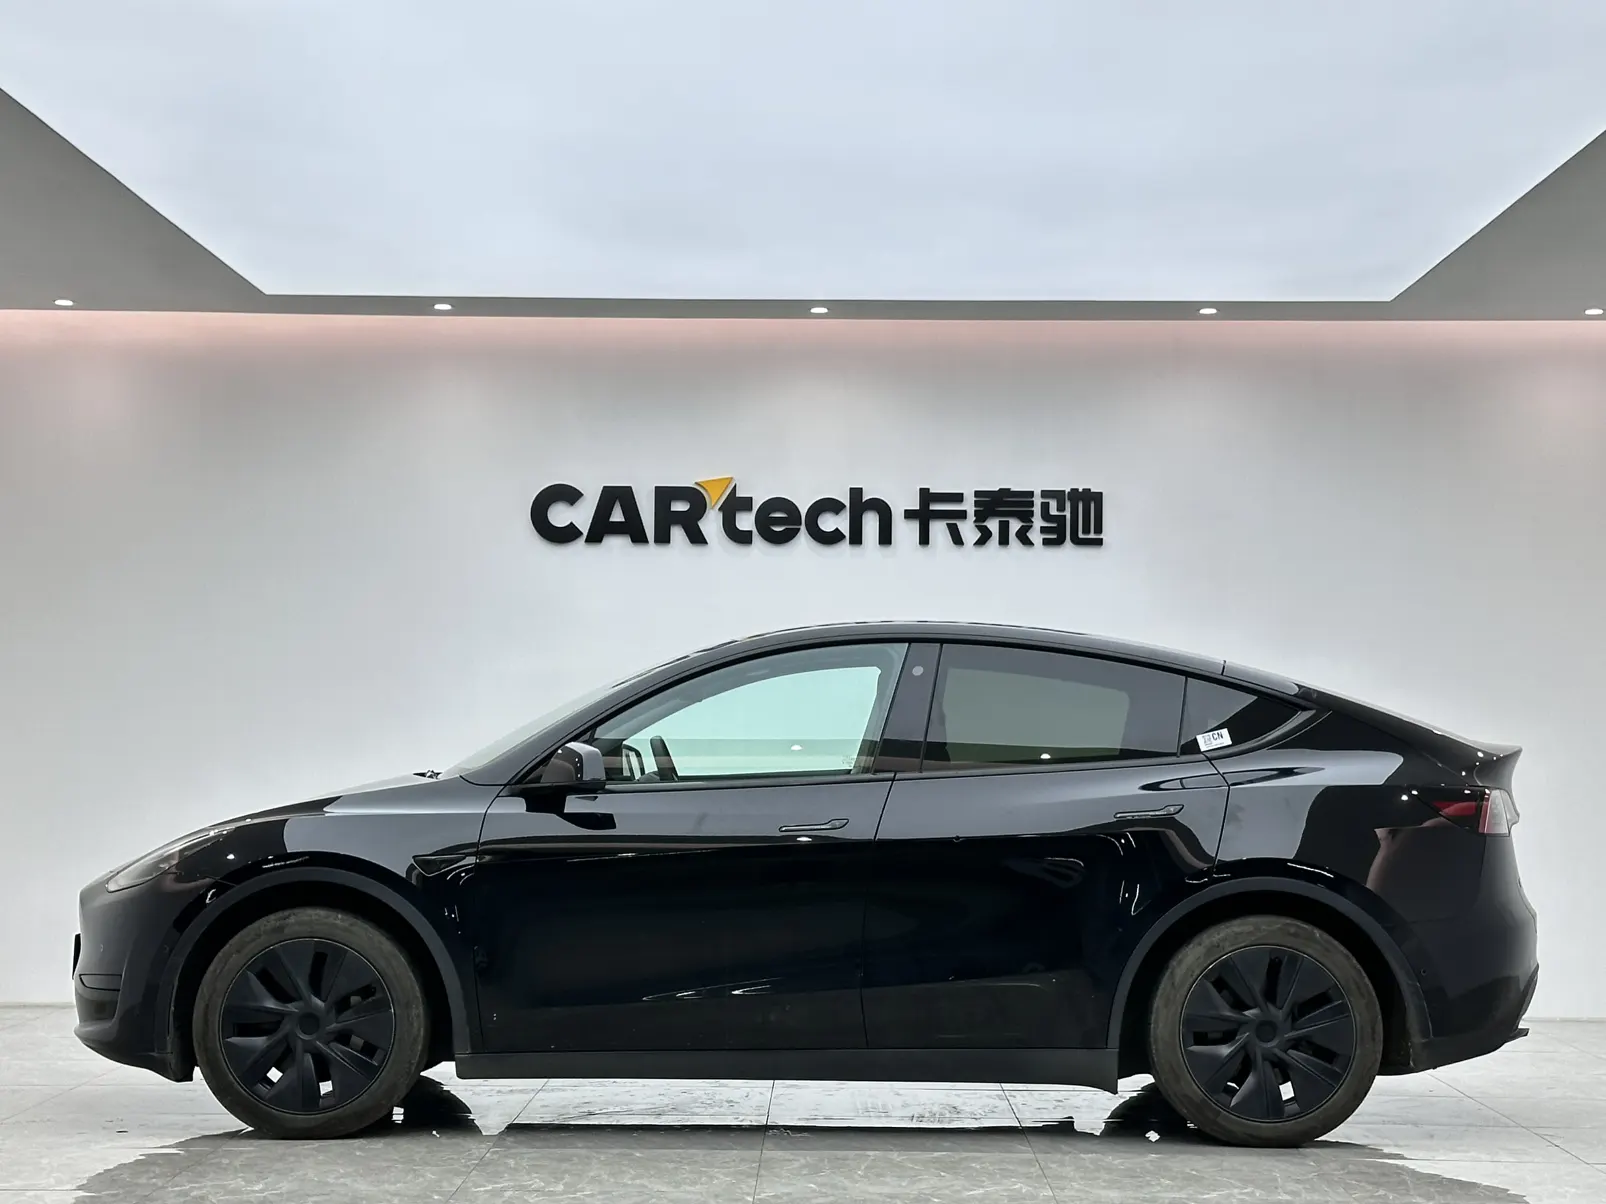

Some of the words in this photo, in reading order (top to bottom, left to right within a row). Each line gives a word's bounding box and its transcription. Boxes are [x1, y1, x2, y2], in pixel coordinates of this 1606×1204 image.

[530, 483, 893, 546] CARtech
[904, 487, 1104, 547] 卡泰驰
[1211, 731, 1224, 741] CN
